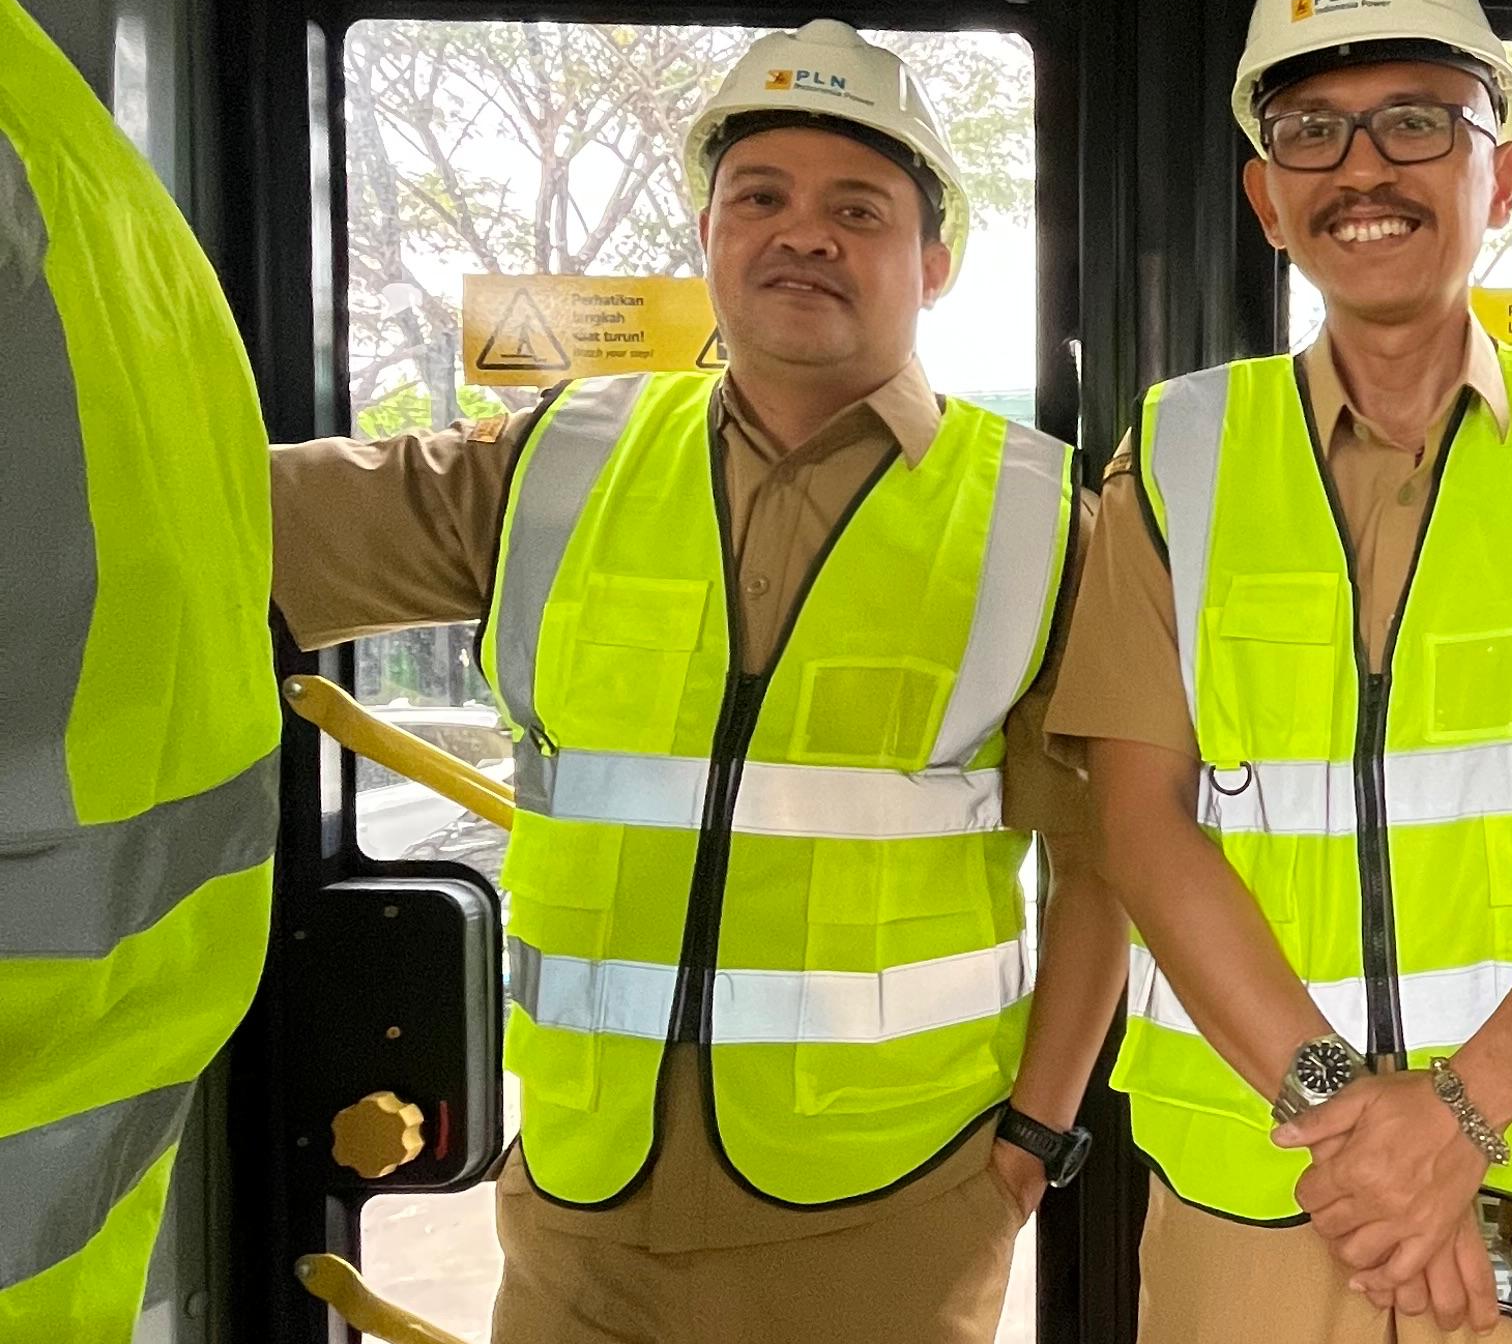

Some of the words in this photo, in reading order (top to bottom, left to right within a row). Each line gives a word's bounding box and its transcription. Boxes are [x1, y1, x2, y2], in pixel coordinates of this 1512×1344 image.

[796, 69, 846, 90] PLN
[572, 294, 644, 306] Perhatikan
[604, 331, 644, 343] turun!
